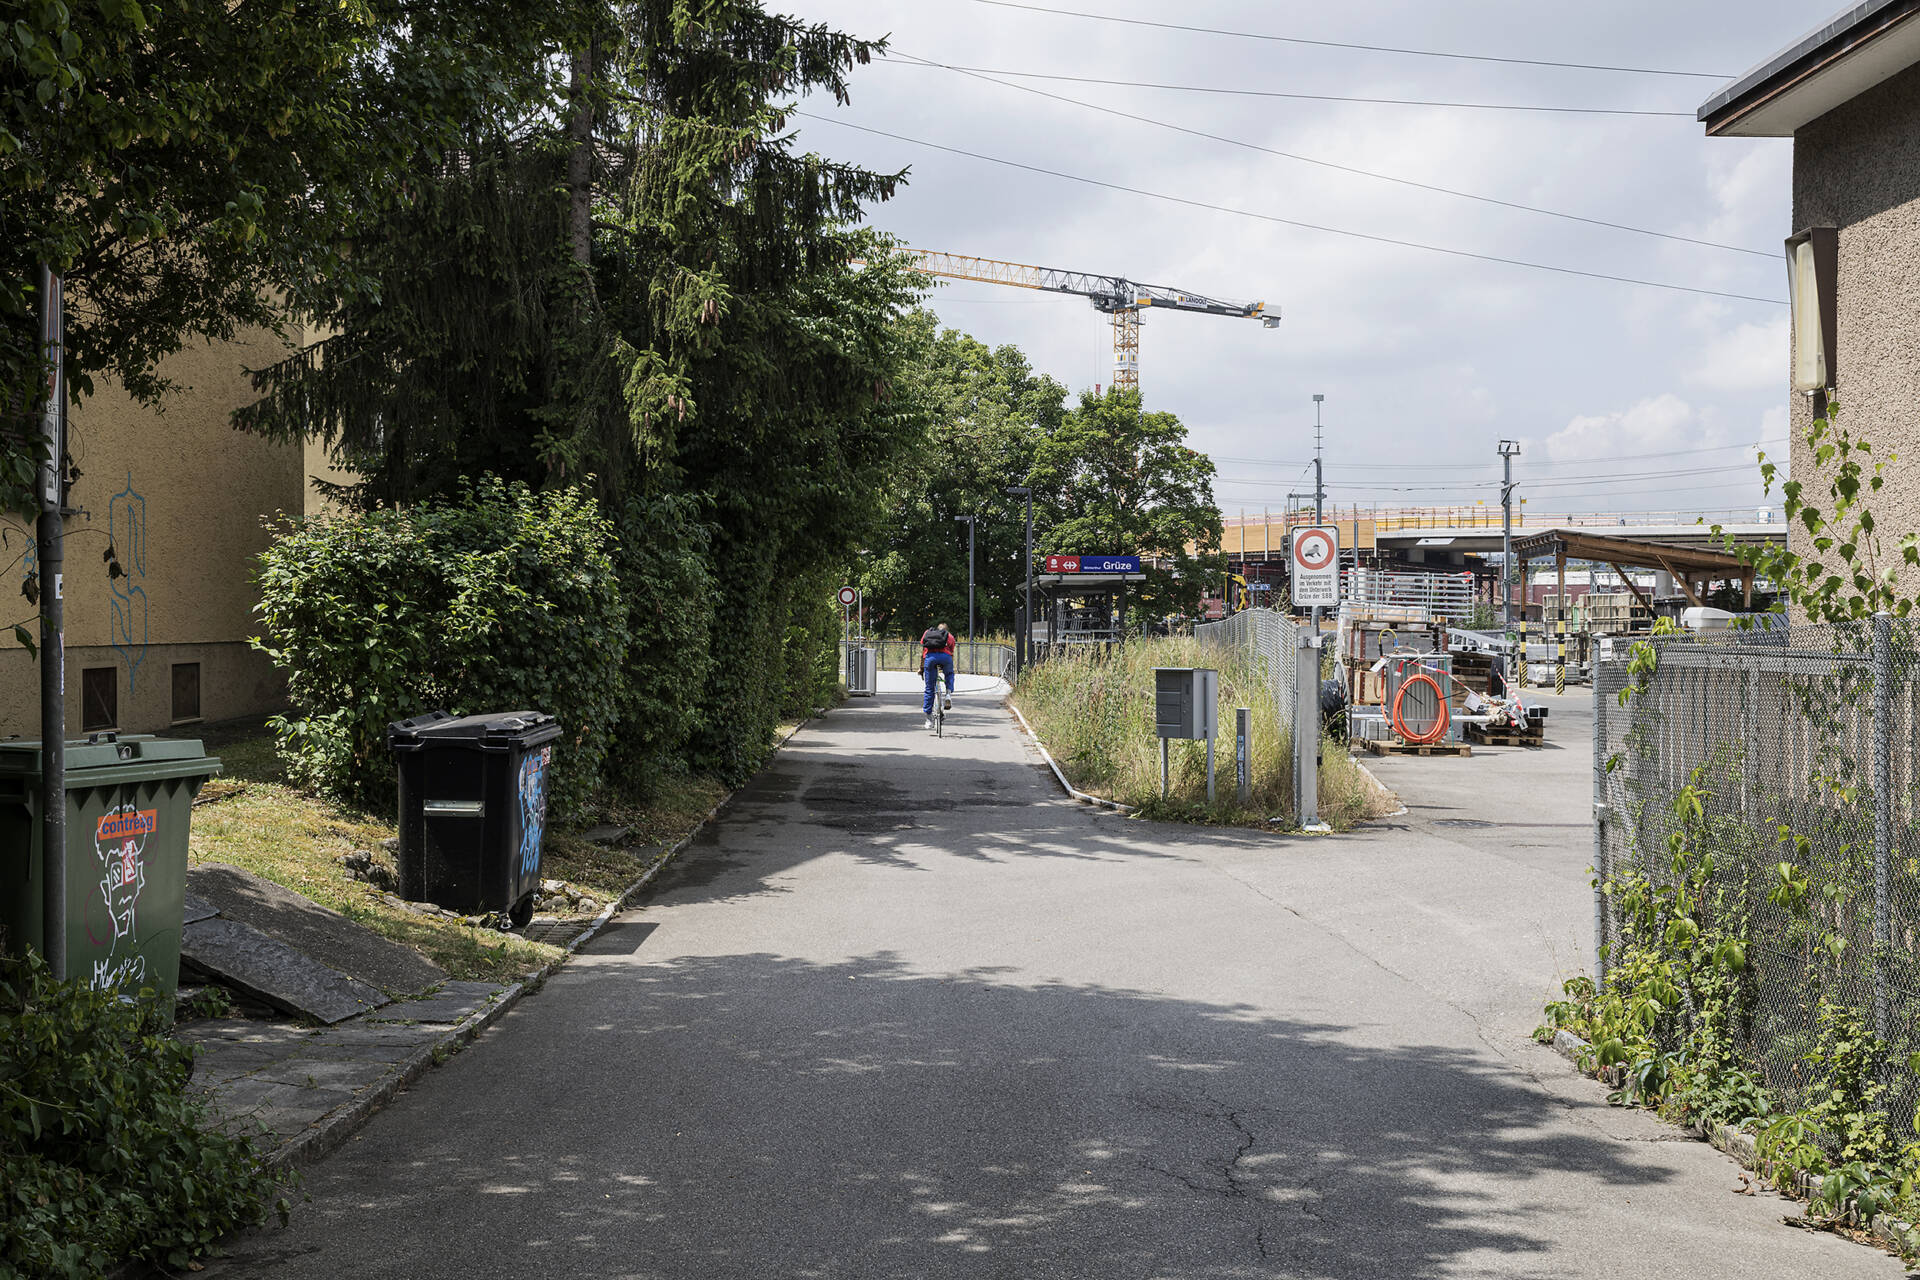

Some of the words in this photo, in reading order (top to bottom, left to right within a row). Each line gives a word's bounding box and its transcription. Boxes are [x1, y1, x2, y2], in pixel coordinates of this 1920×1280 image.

[1186, 296, 1207, 305] LANDOLT
[1103, 561, 1132, 570] Grüze
[102, 814, 154, 836] contreag
